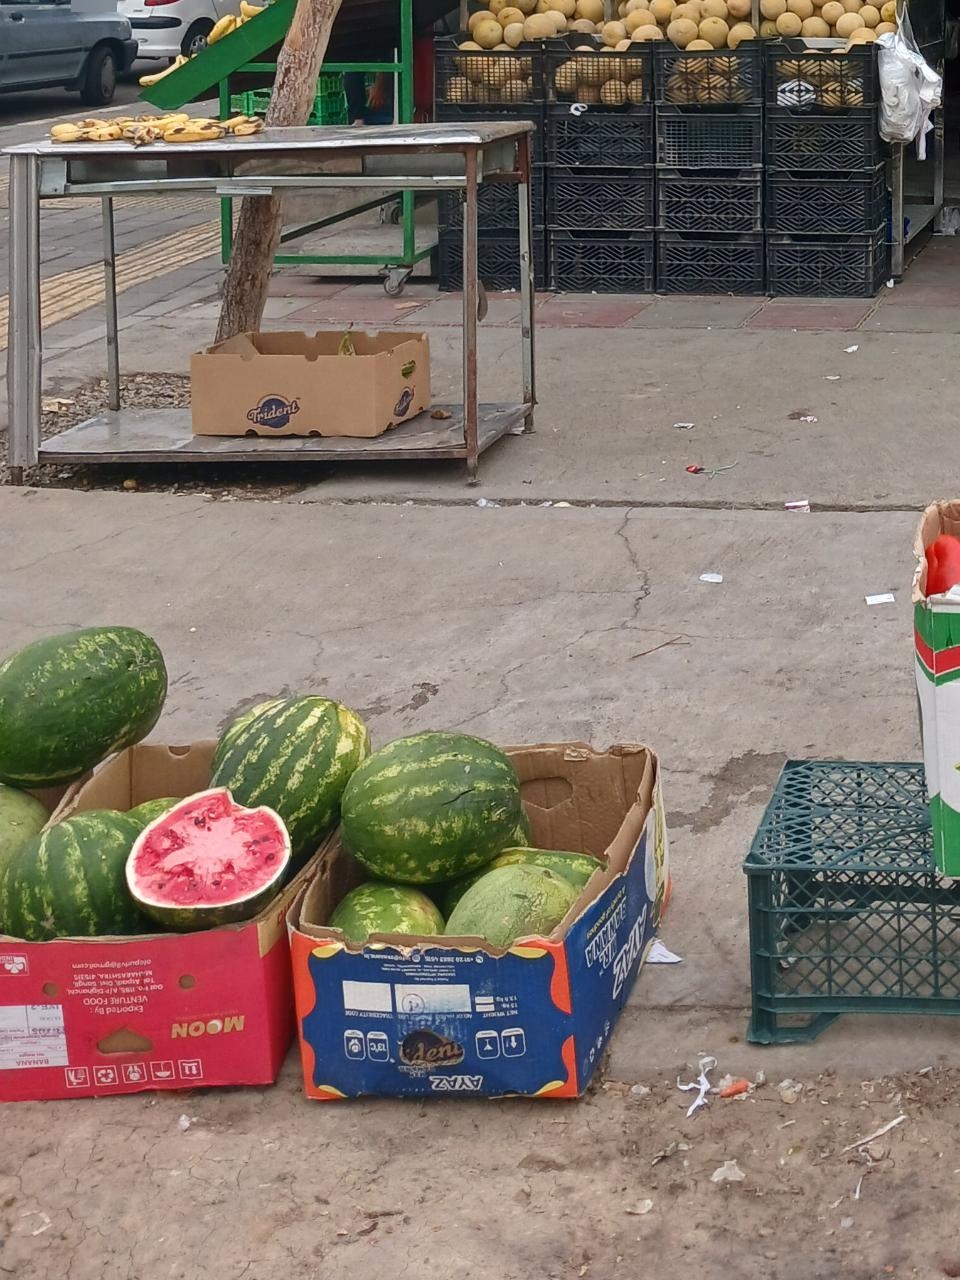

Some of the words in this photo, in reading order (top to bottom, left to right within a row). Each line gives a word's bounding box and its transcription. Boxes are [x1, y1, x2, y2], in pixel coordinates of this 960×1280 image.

[247, 399, 301, 424] Trident
[612, 903, 649, 1001] AYAZ
[83, 997, 108, 1006] FOOD
[110, 995, 149, 1005] VENTURE
[106, 1005, 144, 1015] Exported
[171, 1015, 245, 1040] MOON
[16, 1058, 49, 1067] BANANA
[428, 1075, 483, 1091] AYAZ
